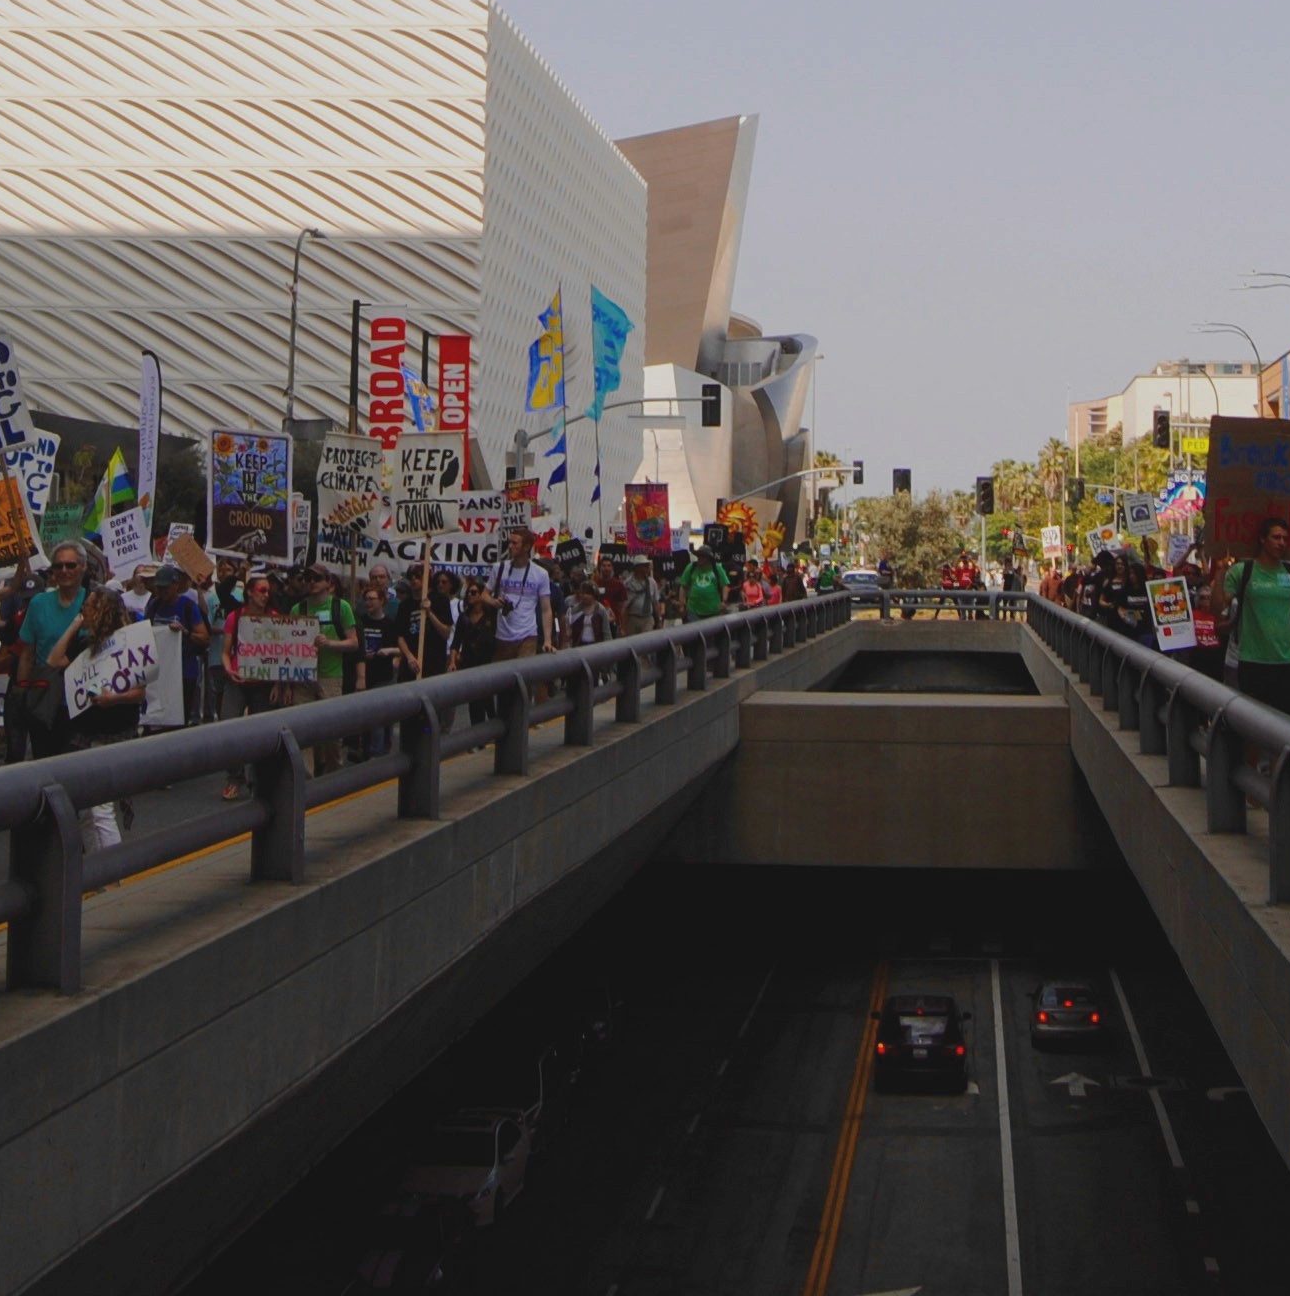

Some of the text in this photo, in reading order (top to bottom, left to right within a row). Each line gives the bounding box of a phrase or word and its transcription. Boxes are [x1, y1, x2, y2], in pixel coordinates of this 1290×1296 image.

[370, 318, 406, 449] BROAD
[442, 363, 466, 424] OPEN
[1187, 441, 1206, 450] PED
[1220, 434, 1289, 467] Break
[6, 453, 52, 474] UP TO
[236, 453, 268, 471] KEEP
[326, 448, 378, 468] PROTECT
[402, 449, 454, 472] KEEP
[246, 473, 254, 482] IT
[337, 465, 359, 474] OUR
[246, 483, 254, 491] IN
[321, 472, 374, 492] CLIMATE
[403, 474, 435, 487] IT IN
[242, 493, 257, 502] THE
[408, 488, 428, 499] THE
[110, 513, 134, 529] DON'T
[229, 510, 273, 530] GROUND
[397, 504, 444, 533] GROUND
[504, 515, 526, 526] THE
[111, 532, 140, 548] FOSSIL
[115, 529, 126, 537] BE
[322, 528, 366, 548] WATR
[117, 545, 138, 557] FOOL
[321, 546, 367, 567] HEALH
[374, 540, 498, 563] ACKING
[662, 561, 675, 572] IN
[111, 645, 155, 669] TAX
[238, 643, 318, 657] GRANDKIDS
[74, 664, 99, 687] WILL
[279, 667, 318, 680] PLANET
